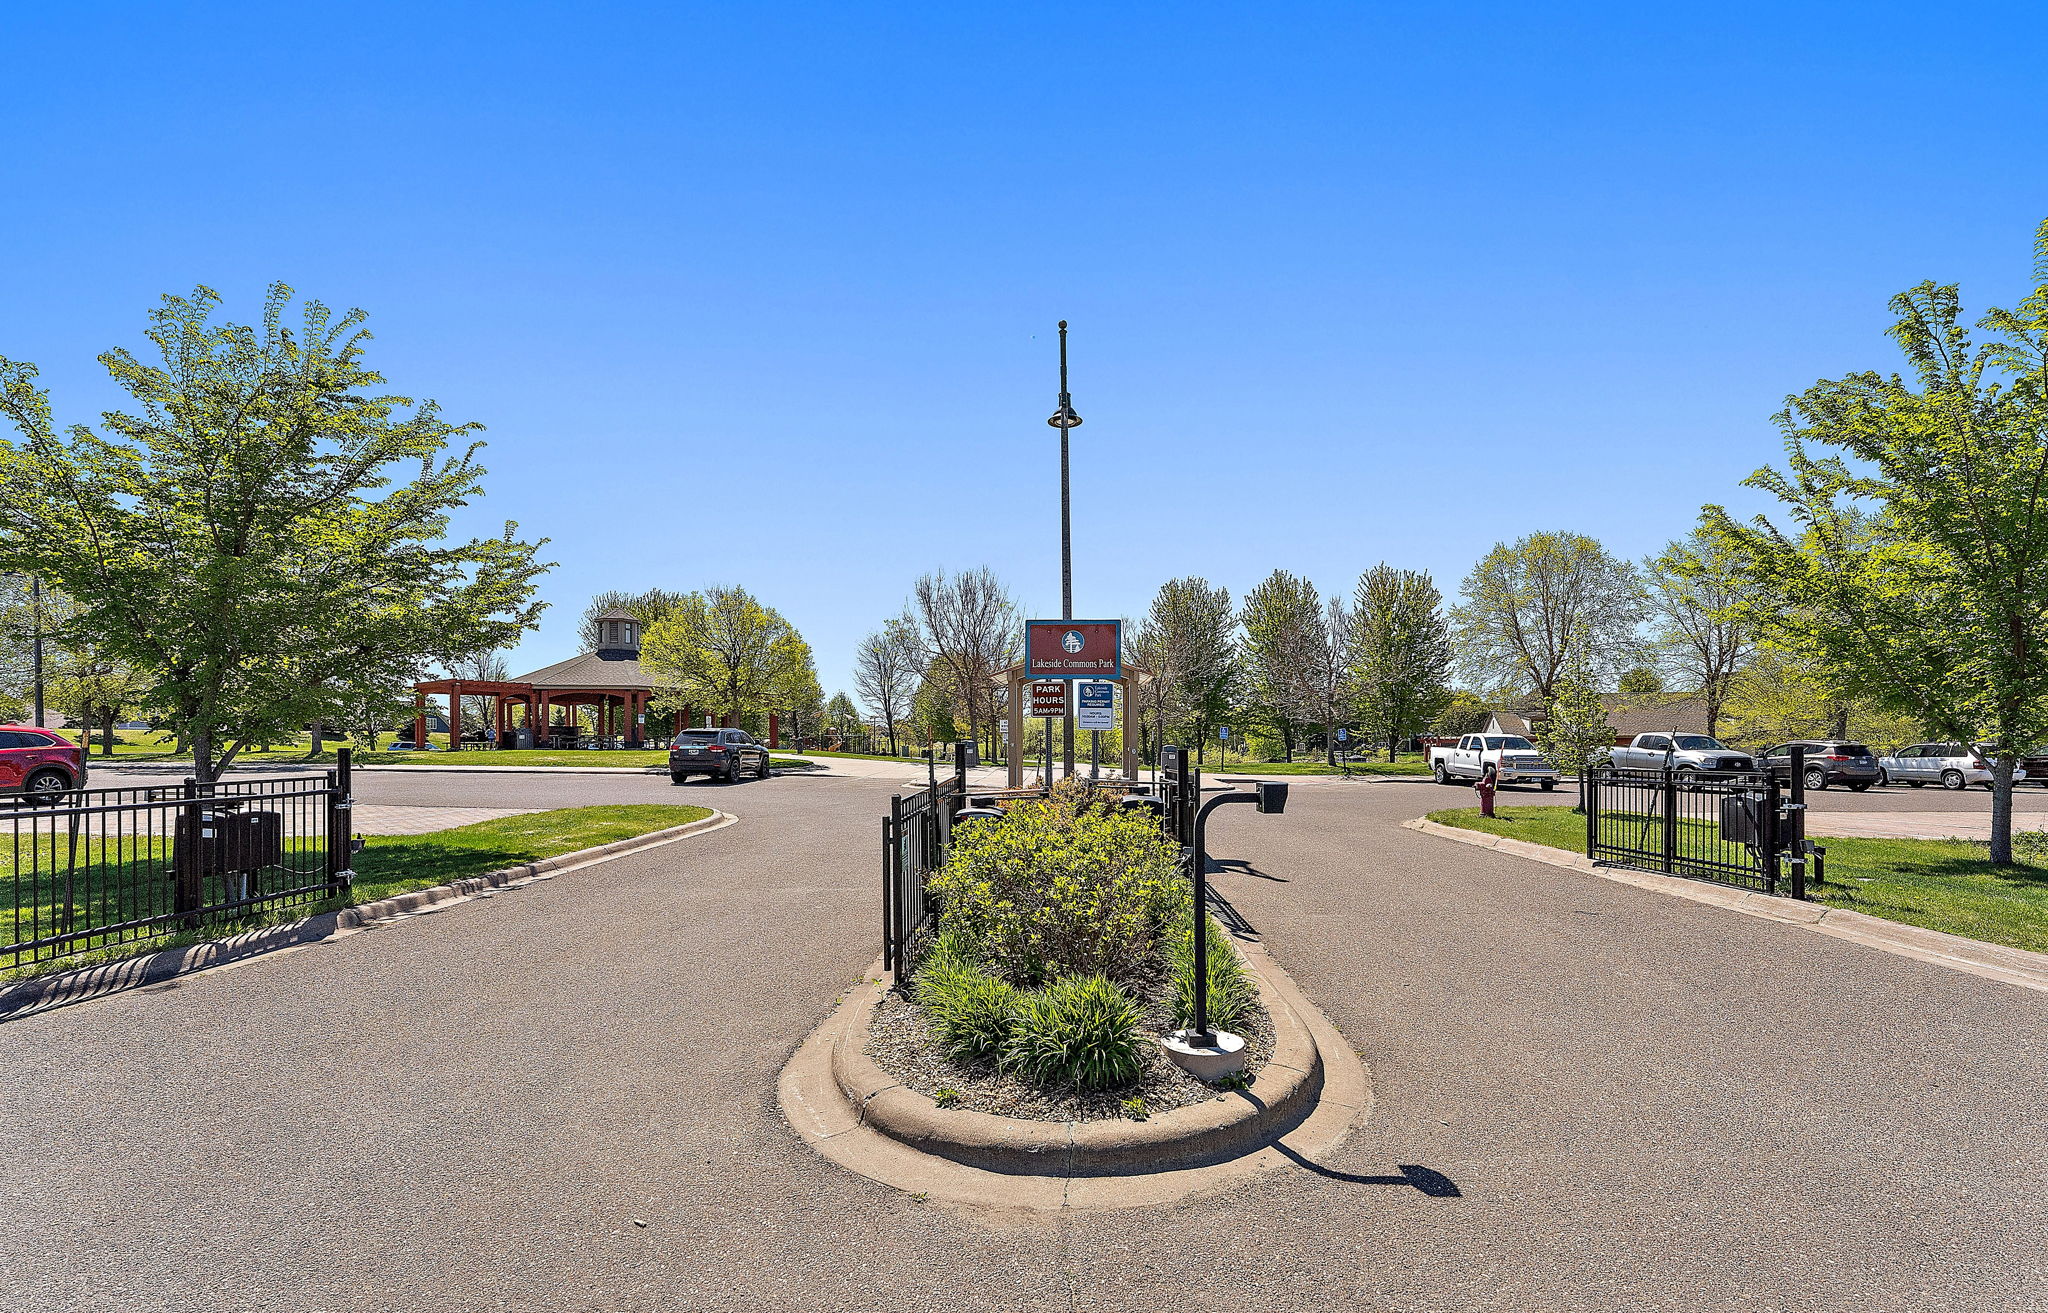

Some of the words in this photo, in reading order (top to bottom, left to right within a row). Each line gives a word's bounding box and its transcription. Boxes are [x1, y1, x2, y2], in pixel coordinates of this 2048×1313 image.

[1032, 659, 1062, 668] Lakeside
[1063, 659, 1097, 668] Commons
[1098, 659, 1114, 668] Park
